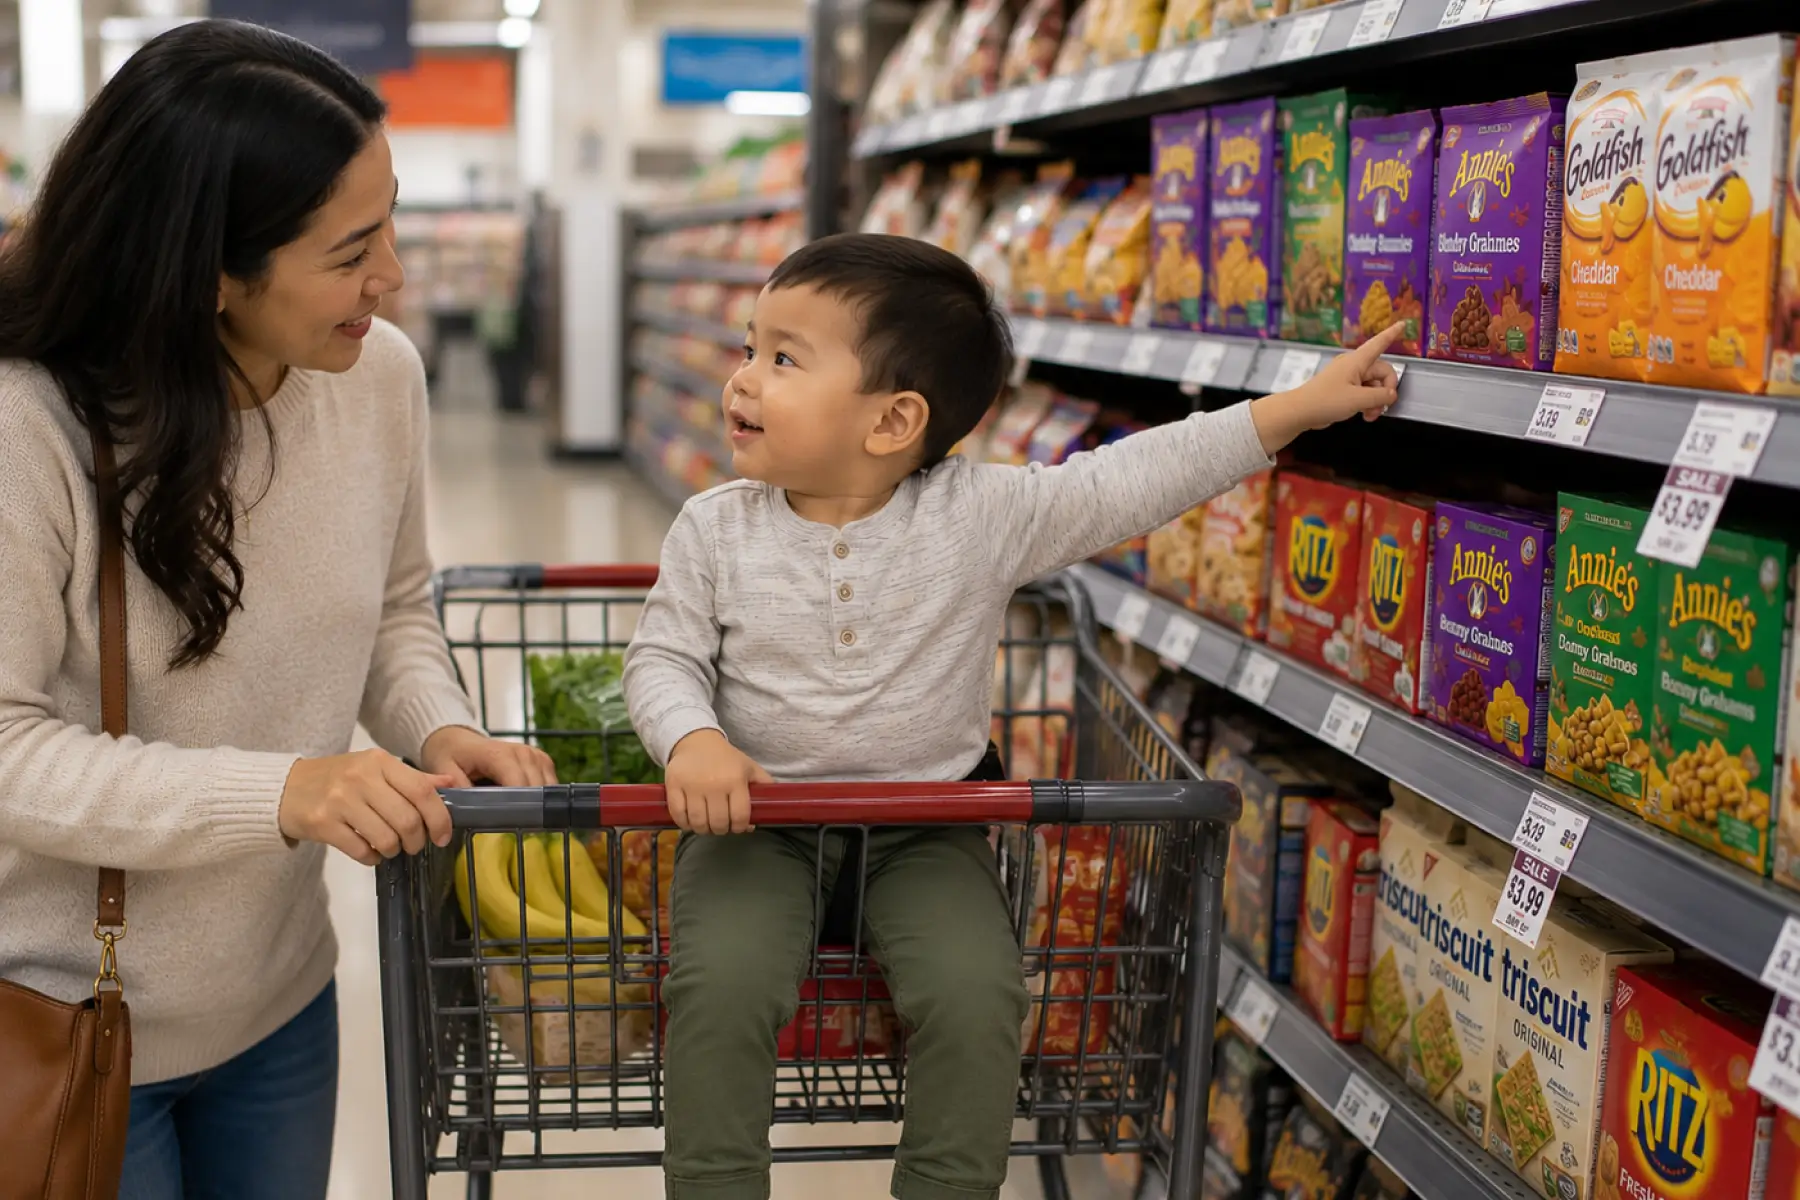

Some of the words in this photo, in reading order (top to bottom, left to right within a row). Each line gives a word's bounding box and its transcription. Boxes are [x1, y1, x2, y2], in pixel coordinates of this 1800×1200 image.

[1358, 149, 1412, 203] Annie's
[1449, 138, 1515, 198] Annie's
[1566, 124, 1644, 197] Goldfish
[1655, 113, 1749, 192] Goldfish
[1571, 259, 1620, 285] Cheddar
[1664, 263, 1722, 292] Cheddar
[1657, 491, 1711, 531] $3.99
[1675, 469, 1721, 492] SALE
[1289, 515, 1335, 581] RITZ
[1372, 537, 1405, 606] RITZ
[1449, 542, 1513, 605] Annie's
[1565, 544, 1639, 612] Annie's
[1669, 571, 1757, 651] Annie's
[1377, 864, 1421, 926] riscu
[1507, 874, 1545, 917] $3.99
[1521, 855, 1551, 883] SALE
[1419, 893, 1495, 983] triscuit
[1501, 947, 1591, 1051] triscuit
[1513, 1018, 1565, 1071] ORIGINAL
[1768, 1024, 1800, 1074] $3.
[1630, 1046, 1708, 1173] RITZ
